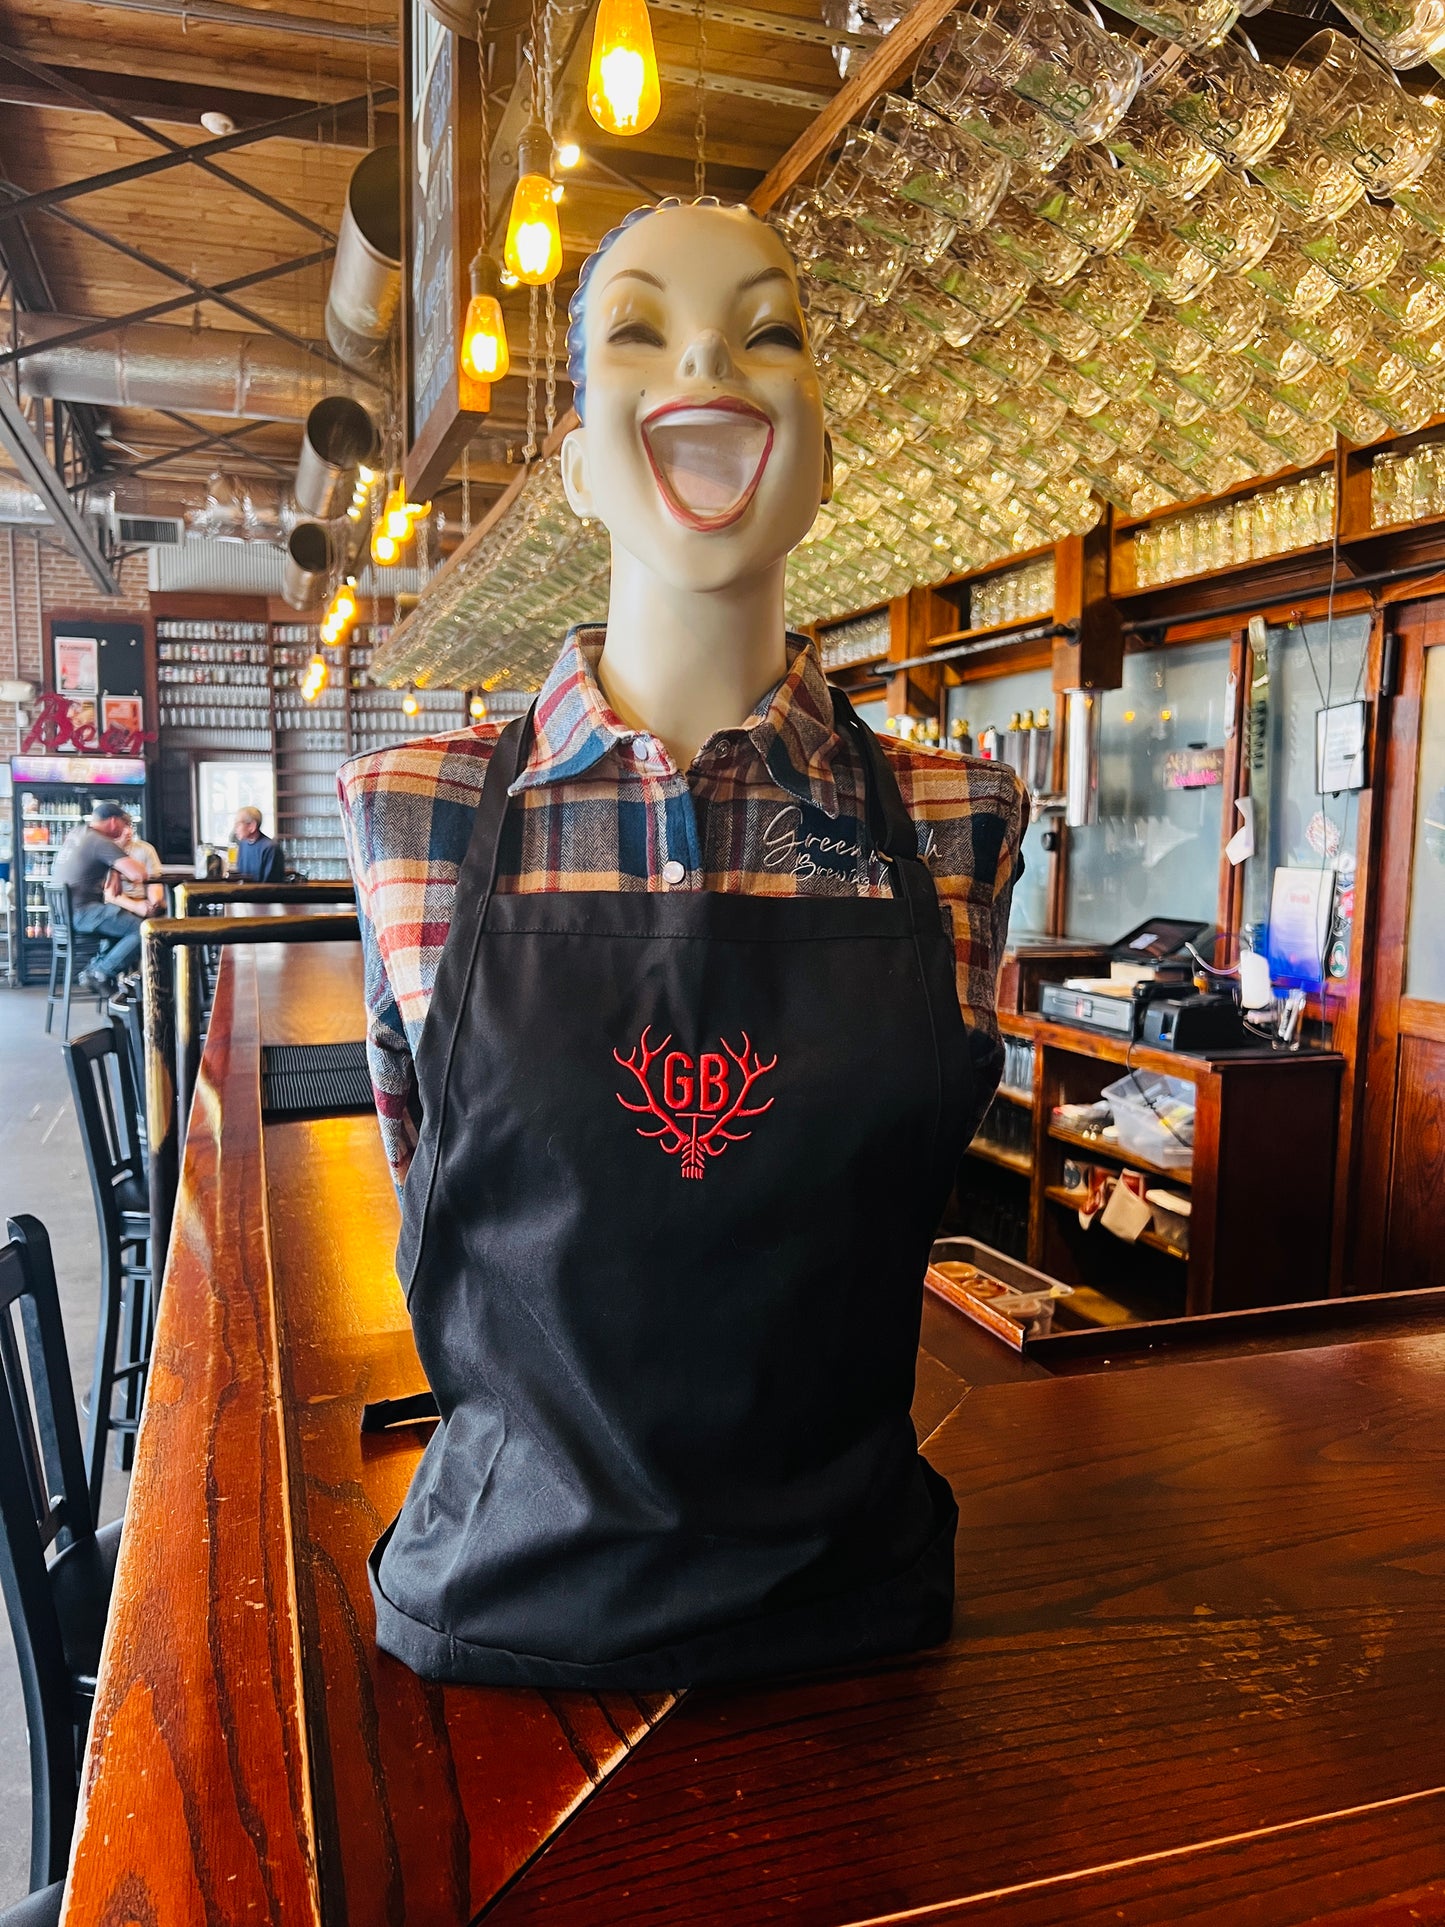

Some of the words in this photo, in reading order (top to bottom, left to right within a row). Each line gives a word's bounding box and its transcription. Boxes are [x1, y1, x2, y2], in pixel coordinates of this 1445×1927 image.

[1352, 142, 1396, 175] GB
[790, 852, 870, 895] Brewing
[663, 1051, 730, 1112] GB
